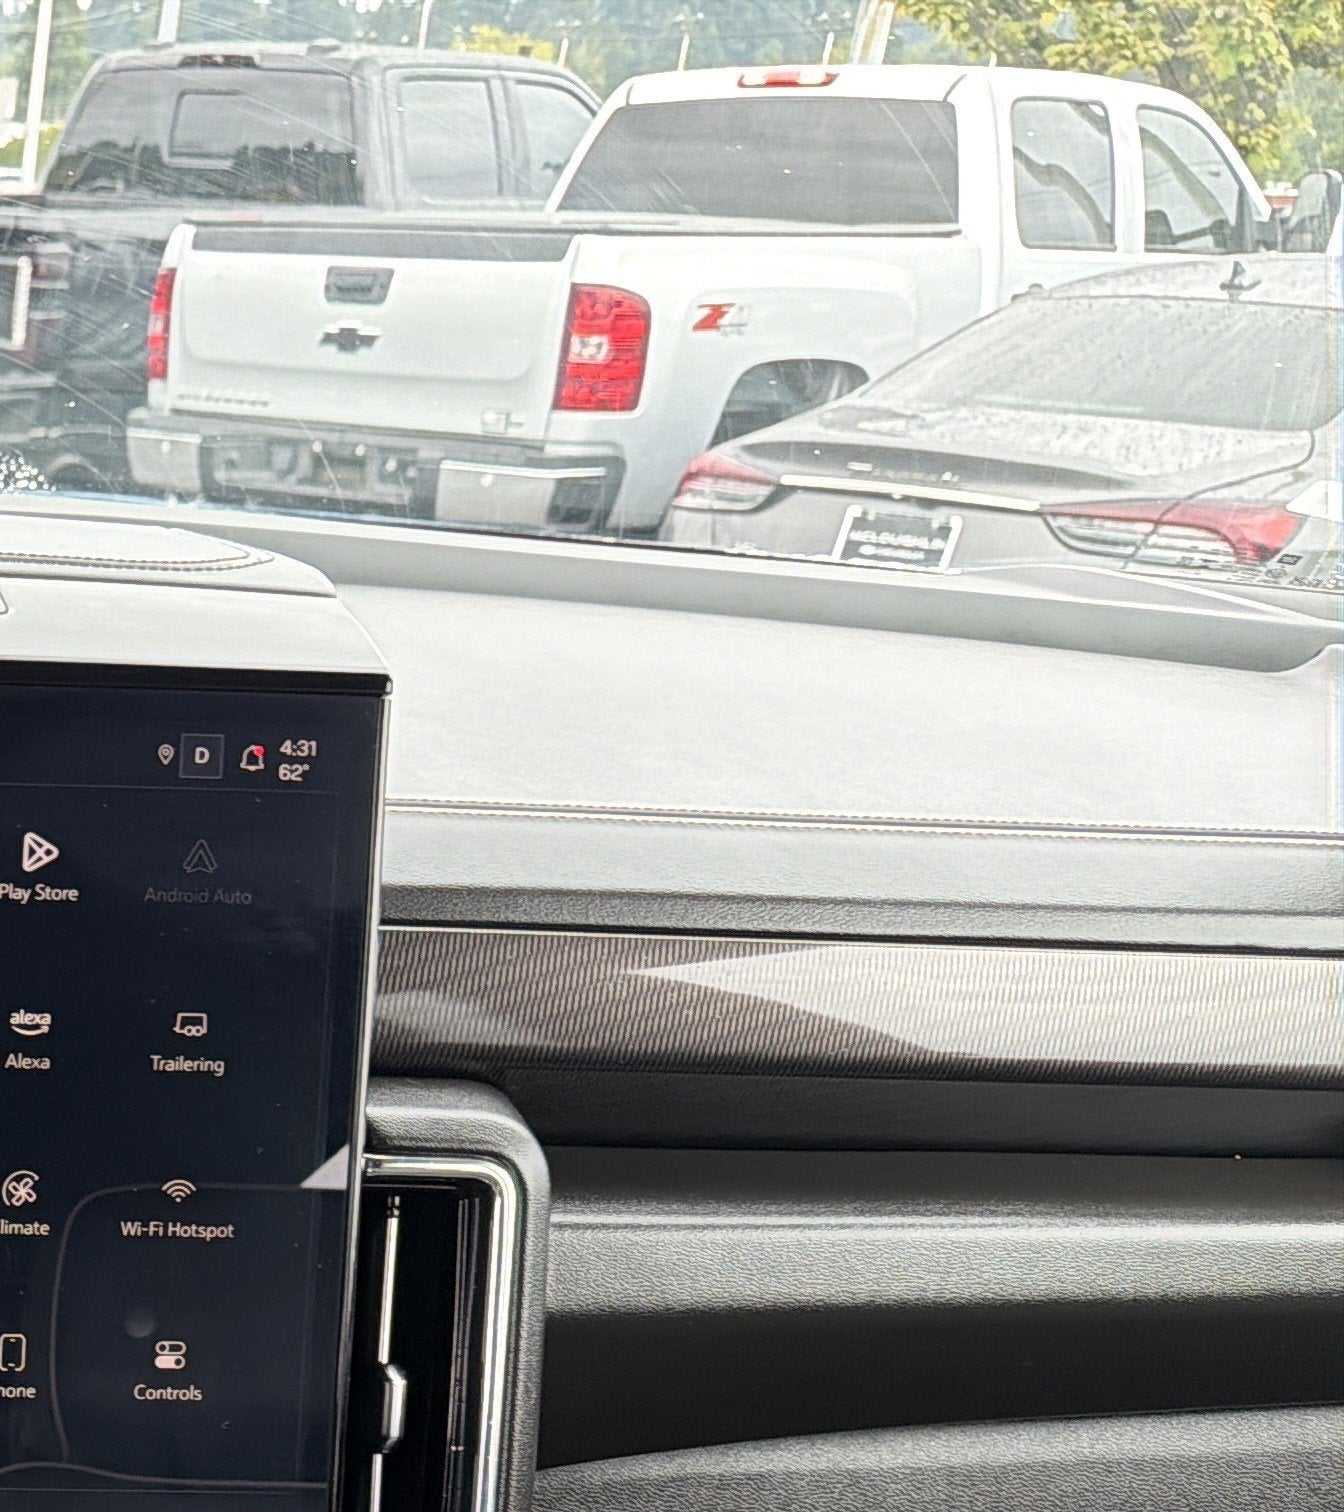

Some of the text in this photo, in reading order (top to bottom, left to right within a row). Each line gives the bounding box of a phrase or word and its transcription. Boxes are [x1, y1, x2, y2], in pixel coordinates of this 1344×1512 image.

[195, 747, 209, 765] D
[279, 740, 317, 757] 4:31
[278, 763, 310, 781] 62°
[35, 884, 79, 901] Store
[144, 887, 252, 905] Android Auto
[10, 1010, 51, 1025] alexa
[5, 1053, 51, 1071] Alexa
[150, 1055, 225, 1076] Trailering
[120, 1221, 234, 1241] Wi-Fi Hotspot
[133, 1384, 202, 1401] Controls
